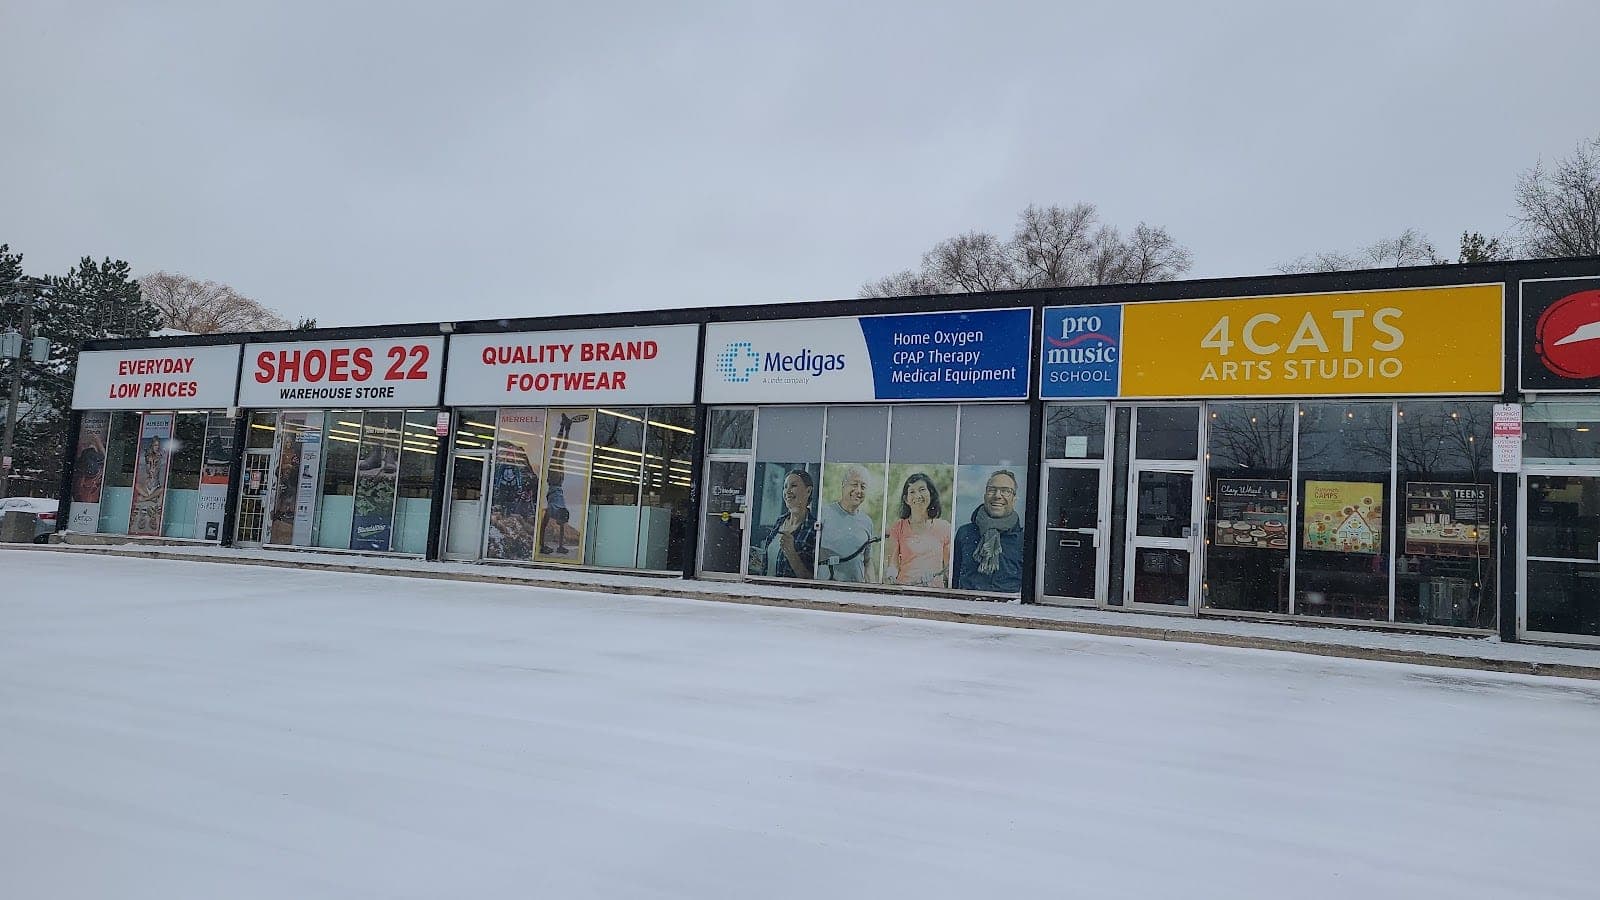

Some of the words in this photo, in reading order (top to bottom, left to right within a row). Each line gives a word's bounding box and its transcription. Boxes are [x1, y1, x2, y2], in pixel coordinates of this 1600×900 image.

[1061, 312, 1101, 340] pro
[1200, 307, 1405, 356] 4CATS
[893, 332, 930, 346] Home
[934, 330, 983, 346] Oxygen
[482, 344, 574, 366] QUALITY
[580, 340, 658, 362] BRAND
[893, 351, 924, 364] CPAP
[928, 350, 981, 365] Therapy
[1047, 342, 1116, 364] music
[118, 358, 194, 376] EVERYDAY
[254, 347, 374, 384] SHOES
[384, 344, 430, 381] 22
[764, 349, 845, 377] Medigas
[1199, 360, 1272, 381] ARTS
[1283, 357, 1404, 380] STUDIO
[506, 371, 627, 392] FOOTWEAR
[891, 369, 941, 383] Medical
[945, 366, 1016, 385] Equipment
[1050, 370, 1112, 383] SCHOOL
[109, 383, 141, 399] LOW
[143, 381, 198, 398] PRICES
[280, 387, 352, 400] WAREHOUSE
[355, 386, 394, 399] STORE
[501, 415, 540, 423] MERRELL
[1221, 484, 1239, 496] Clay
[1314, 491, 1338, 499] CAMPS
[1454, 489, 1485, 499] TEENS
